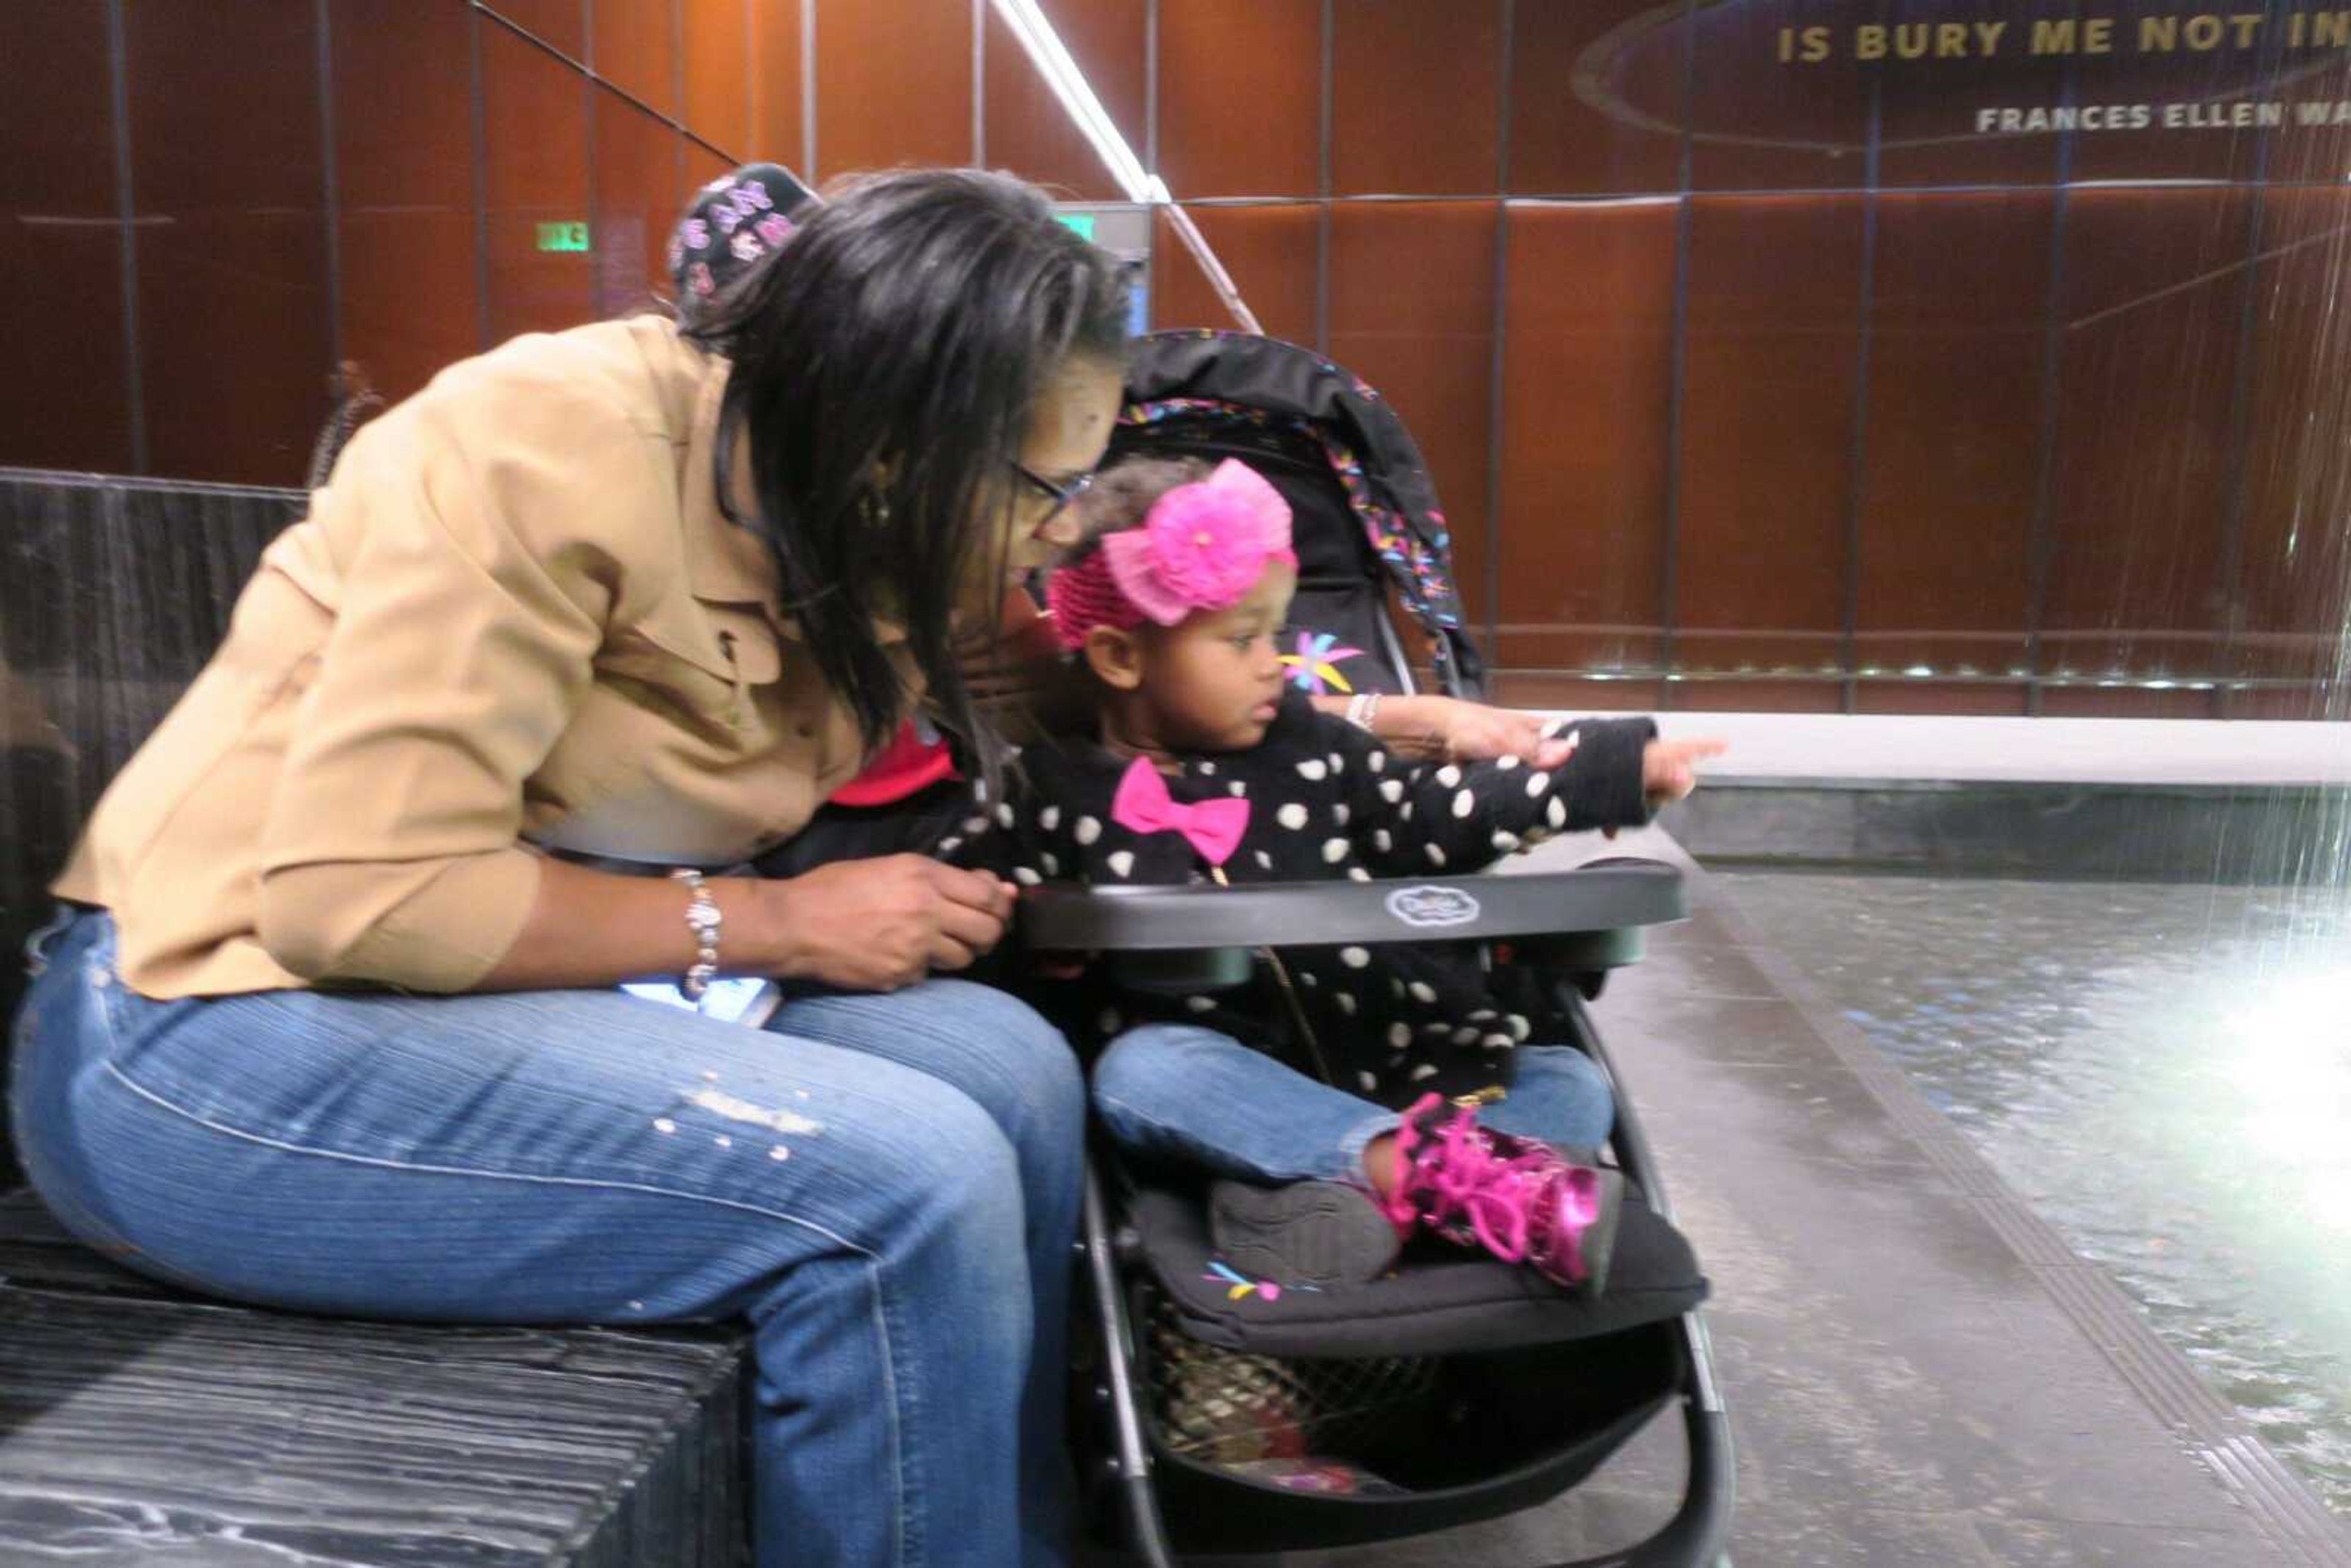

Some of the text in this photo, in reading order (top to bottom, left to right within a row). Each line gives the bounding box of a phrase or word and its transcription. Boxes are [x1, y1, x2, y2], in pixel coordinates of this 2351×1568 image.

[1779, 27, 1831, 62] IS
[1857, 22, 2007, 60] BURY
[2030, 18, 2115, 54] ME
[2140, 15, 2263, 51] NOT
[1976, 105, 2150, 132] FRANCES
[2164, 103, 2282, 127] ELLEN
